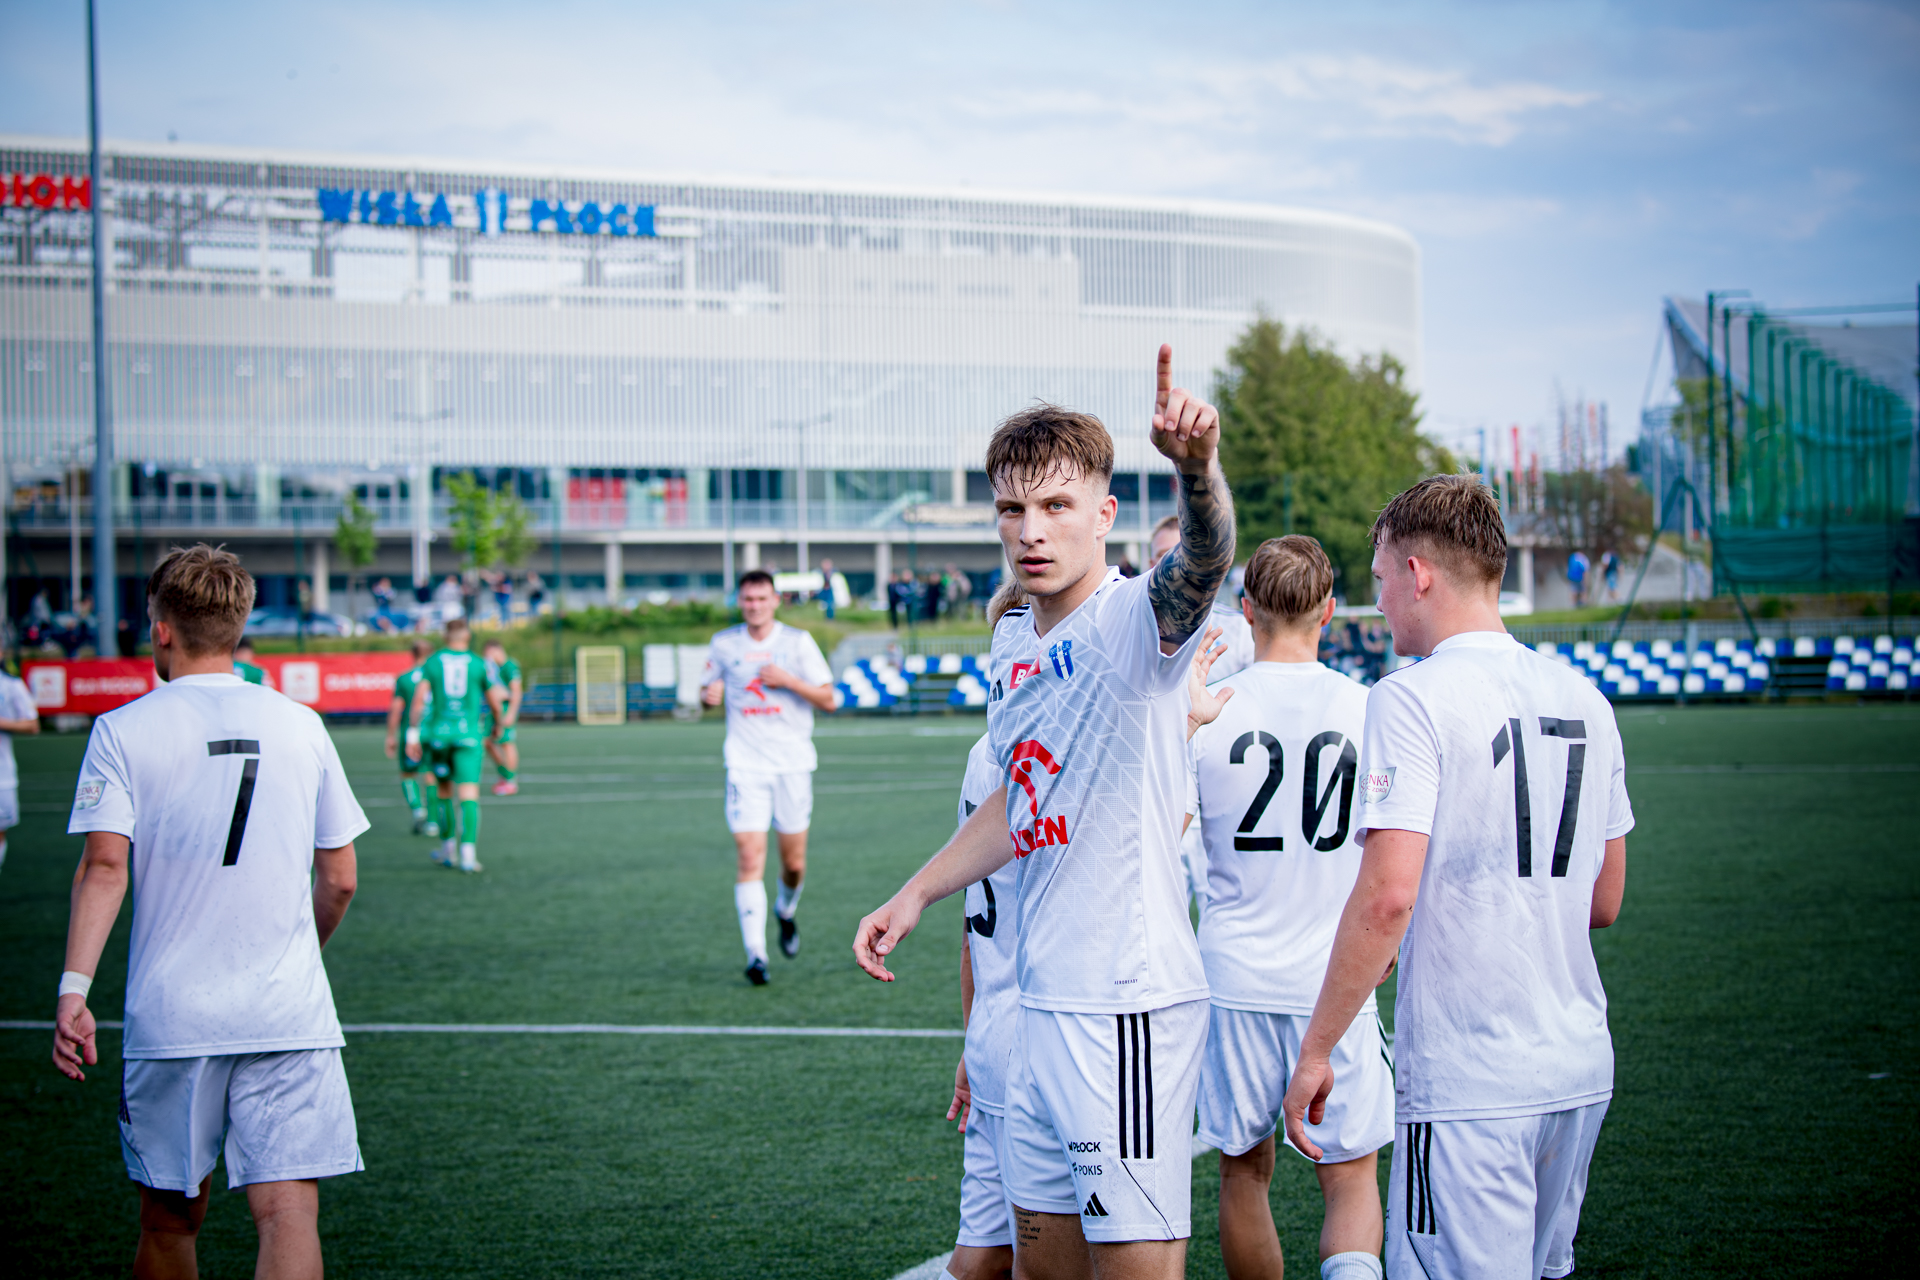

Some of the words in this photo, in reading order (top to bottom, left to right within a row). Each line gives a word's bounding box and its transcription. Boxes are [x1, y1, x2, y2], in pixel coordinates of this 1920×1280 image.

[0, 174, 93, 209] ION
[207, 738, 260, 866] 7
[1229, 730, 1358, 852] 20
[1491, 716, 1587, 877] 17
[1078, 1165, 1103, 1176] POKIS
